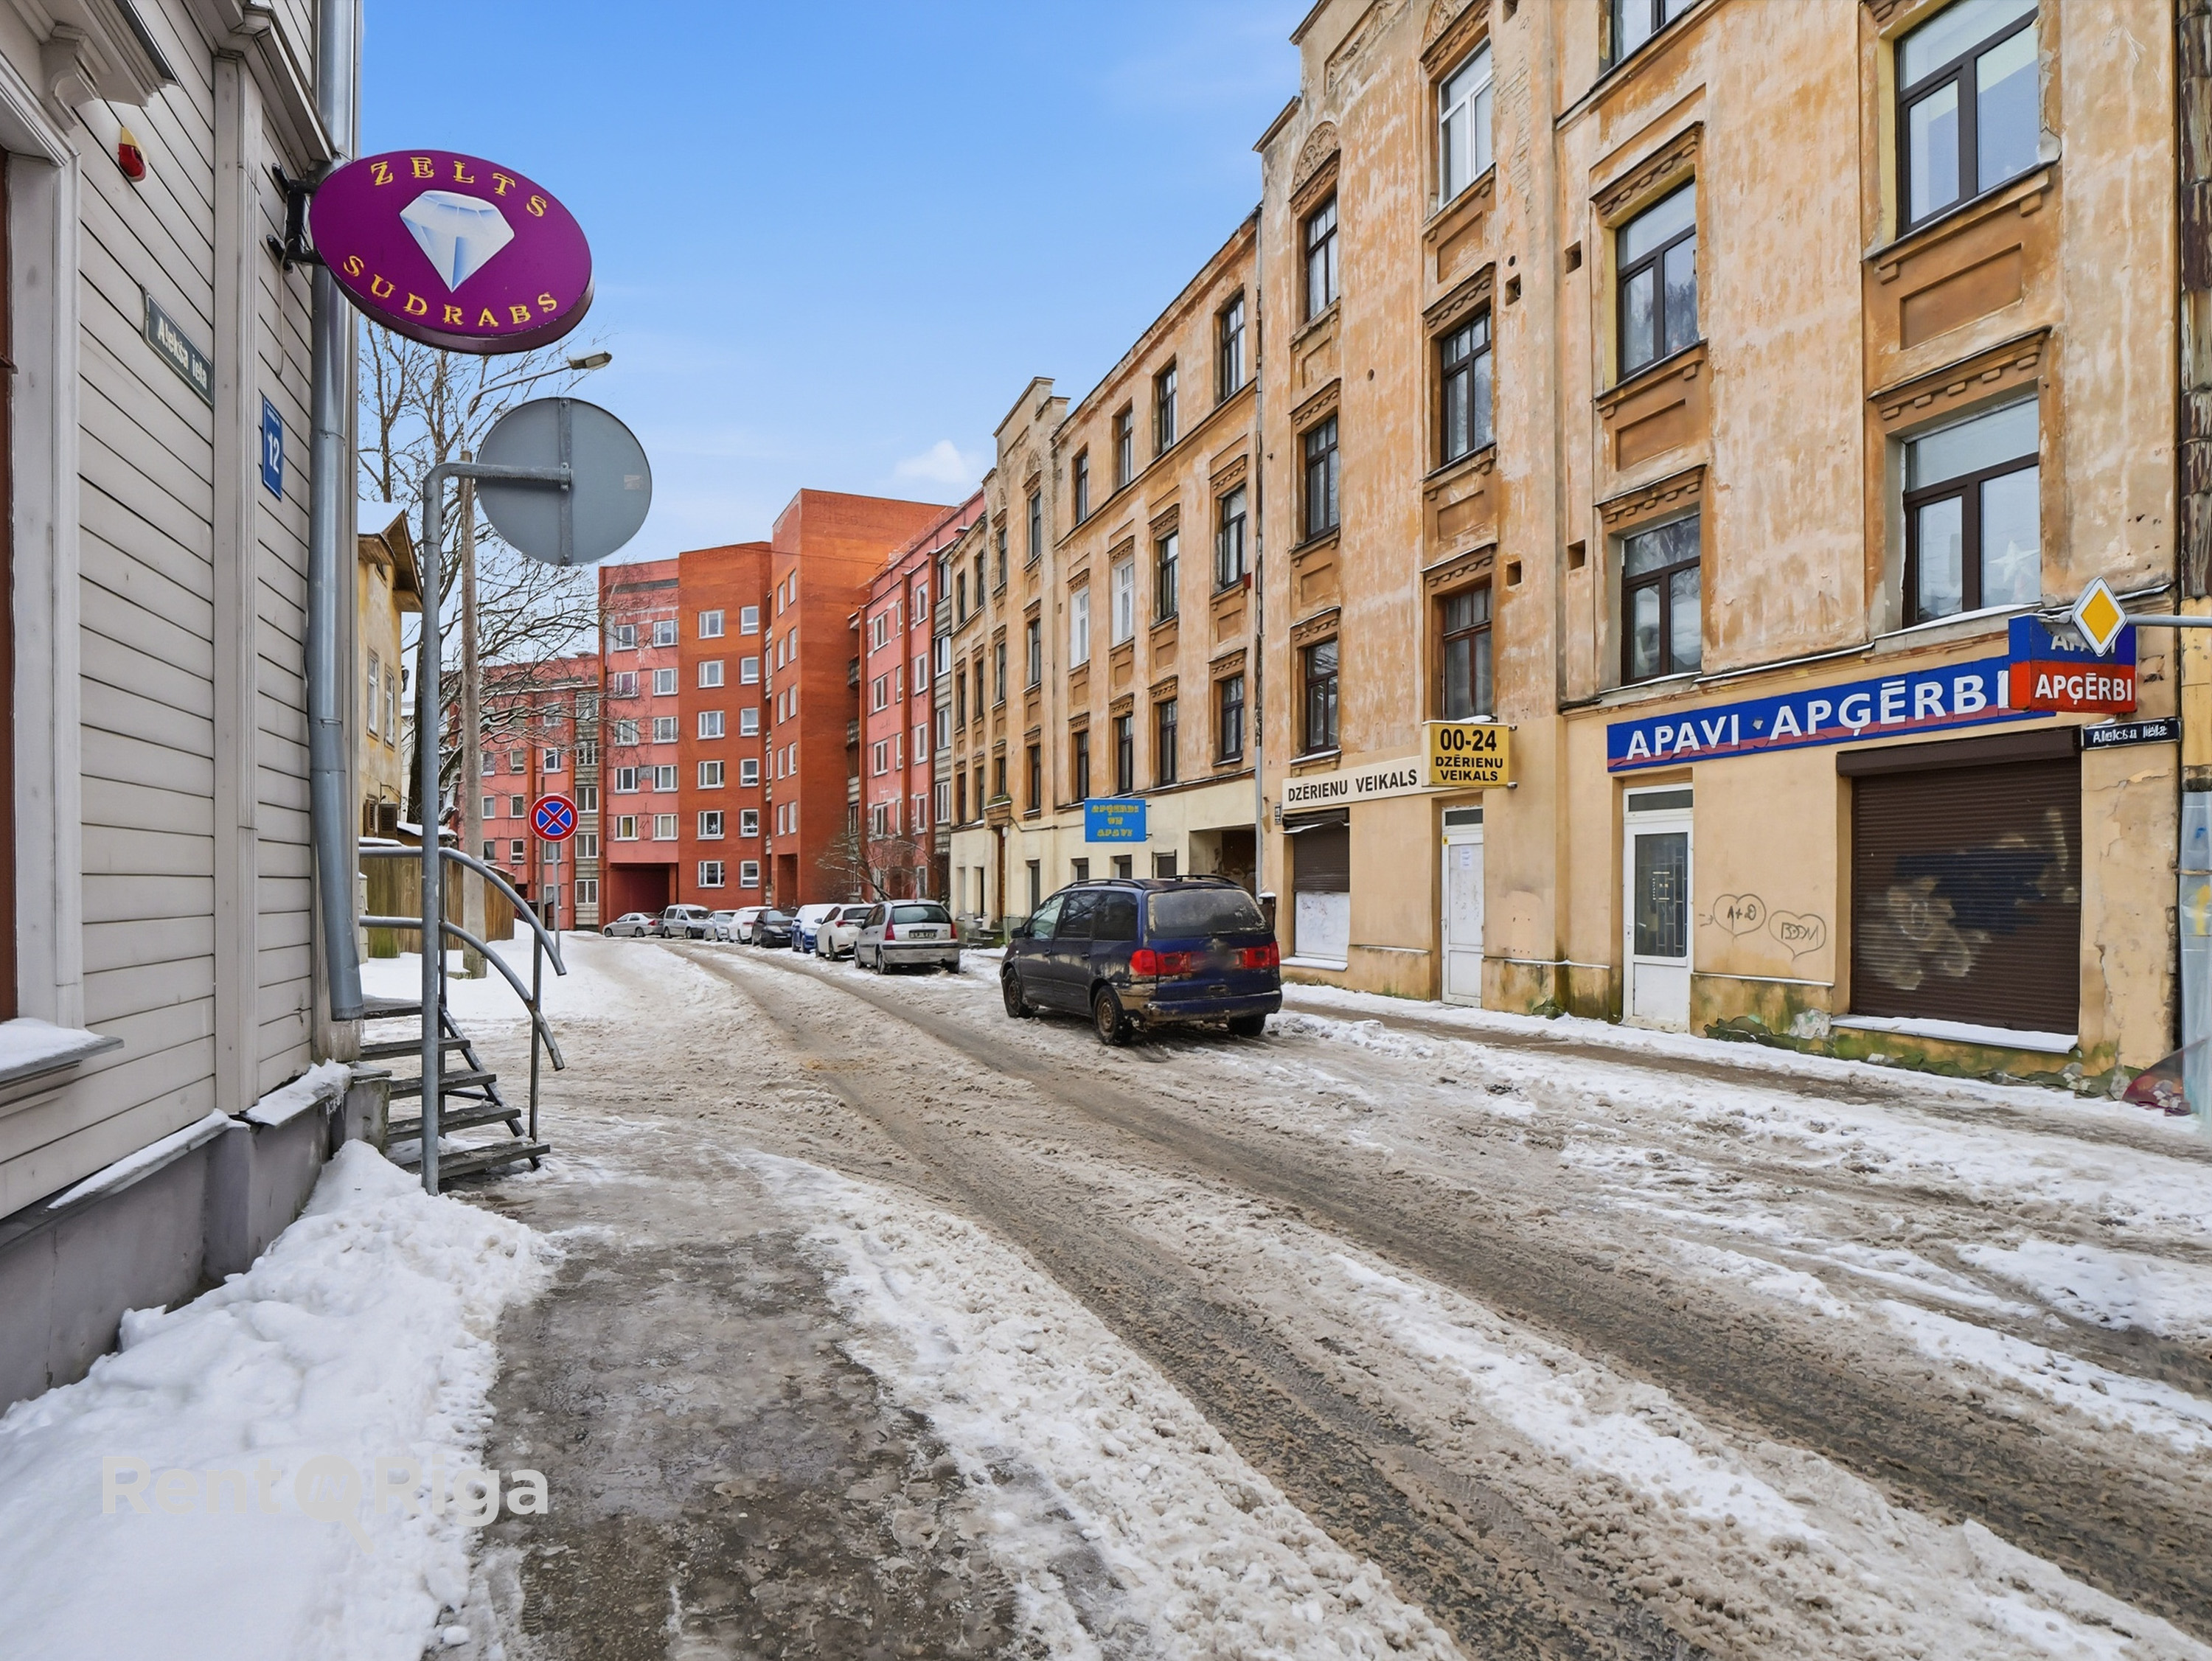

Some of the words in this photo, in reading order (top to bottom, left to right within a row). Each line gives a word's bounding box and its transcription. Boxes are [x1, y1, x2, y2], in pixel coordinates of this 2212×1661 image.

[371, 157, 548, 217] ZELTS
[344, 255, 558, 327] SUDRABS
[268, 431, 280, 474] 12
[2034, 672, 2132, 705] APĢĒRBI
[1626, 714, 1739, 761] APAVI
[1769, 670, 2008, 737] APĢĒRBI
[1440, 728, 1498, 752] 00-24
[1435, 754, 1503, 768] DZĒRIENU
[1440, 770, 1498, 781] VEIKALS
[1288, 779, 1349, 802] DZĒRIENU
[1355, 769, 1417, 793] VEIKALS
